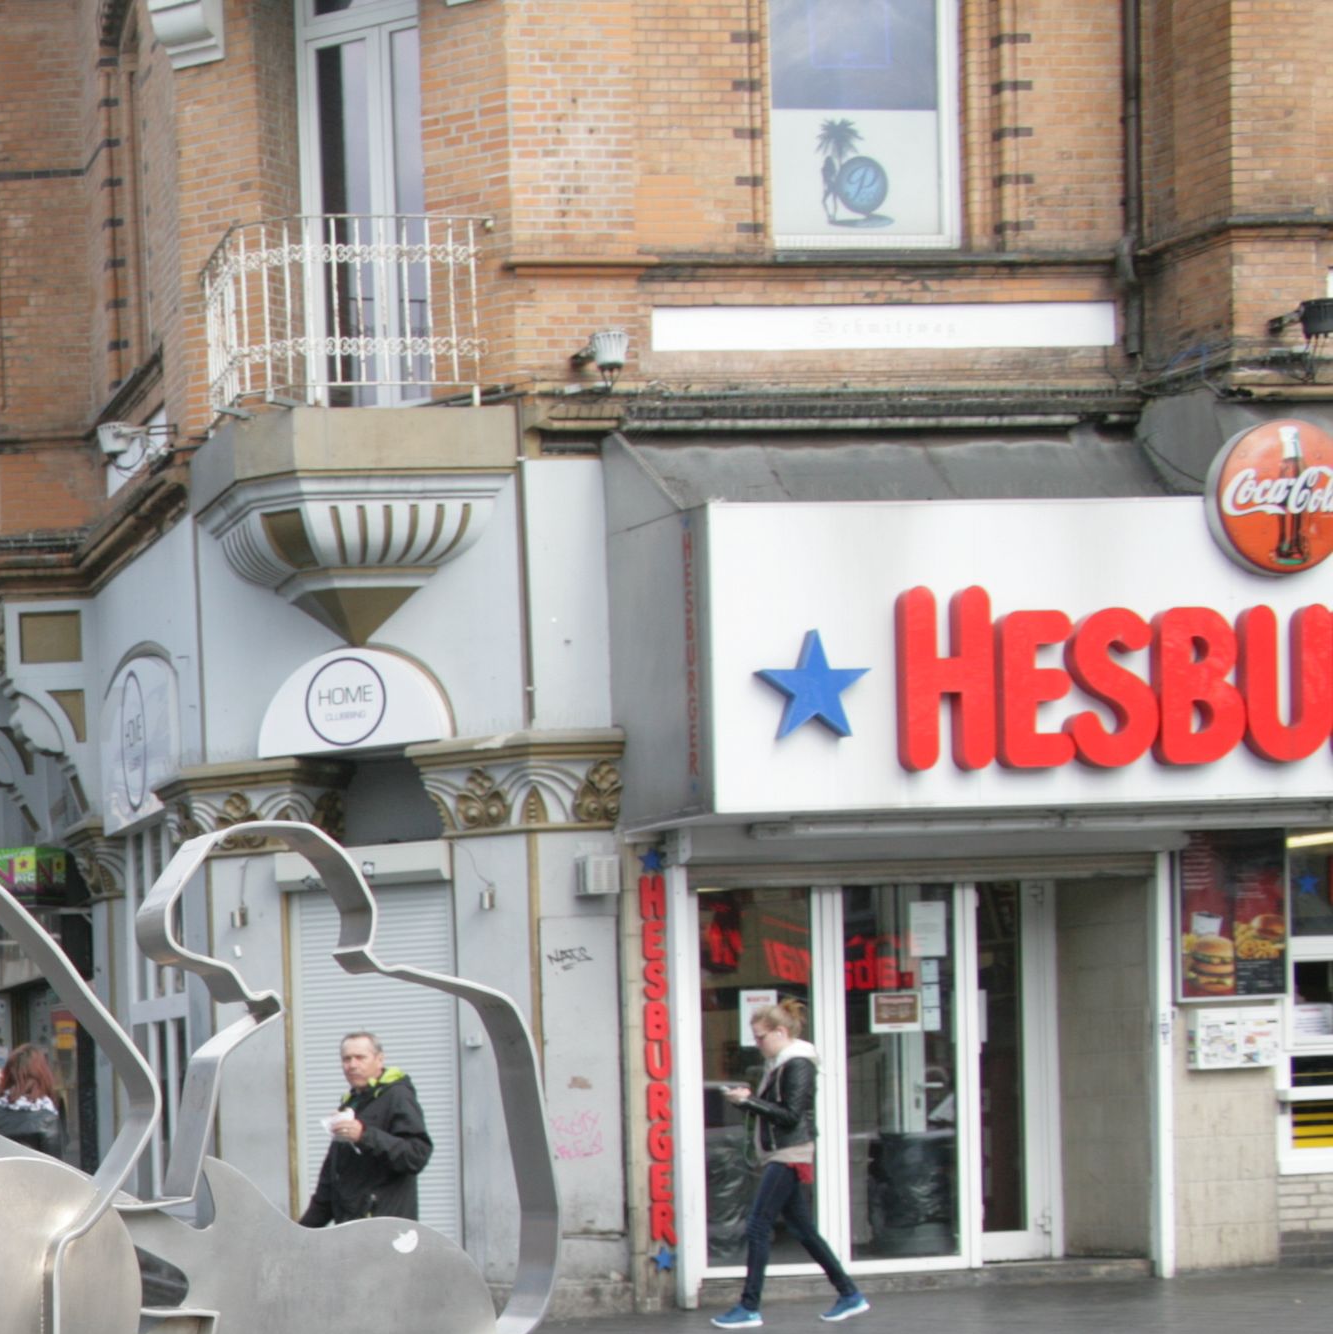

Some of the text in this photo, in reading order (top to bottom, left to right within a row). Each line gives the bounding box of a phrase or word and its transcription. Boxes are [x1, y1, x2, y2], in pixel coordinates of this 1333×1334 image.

[317, 684, 374, 707] HOME
[325, 710, 367, 721] CLUBBING
[683, 532, 700, 777] HESBURGER
[894, 585, 1333, 773] HESBU
[639, 874, 677, 1246] HESBURGER
